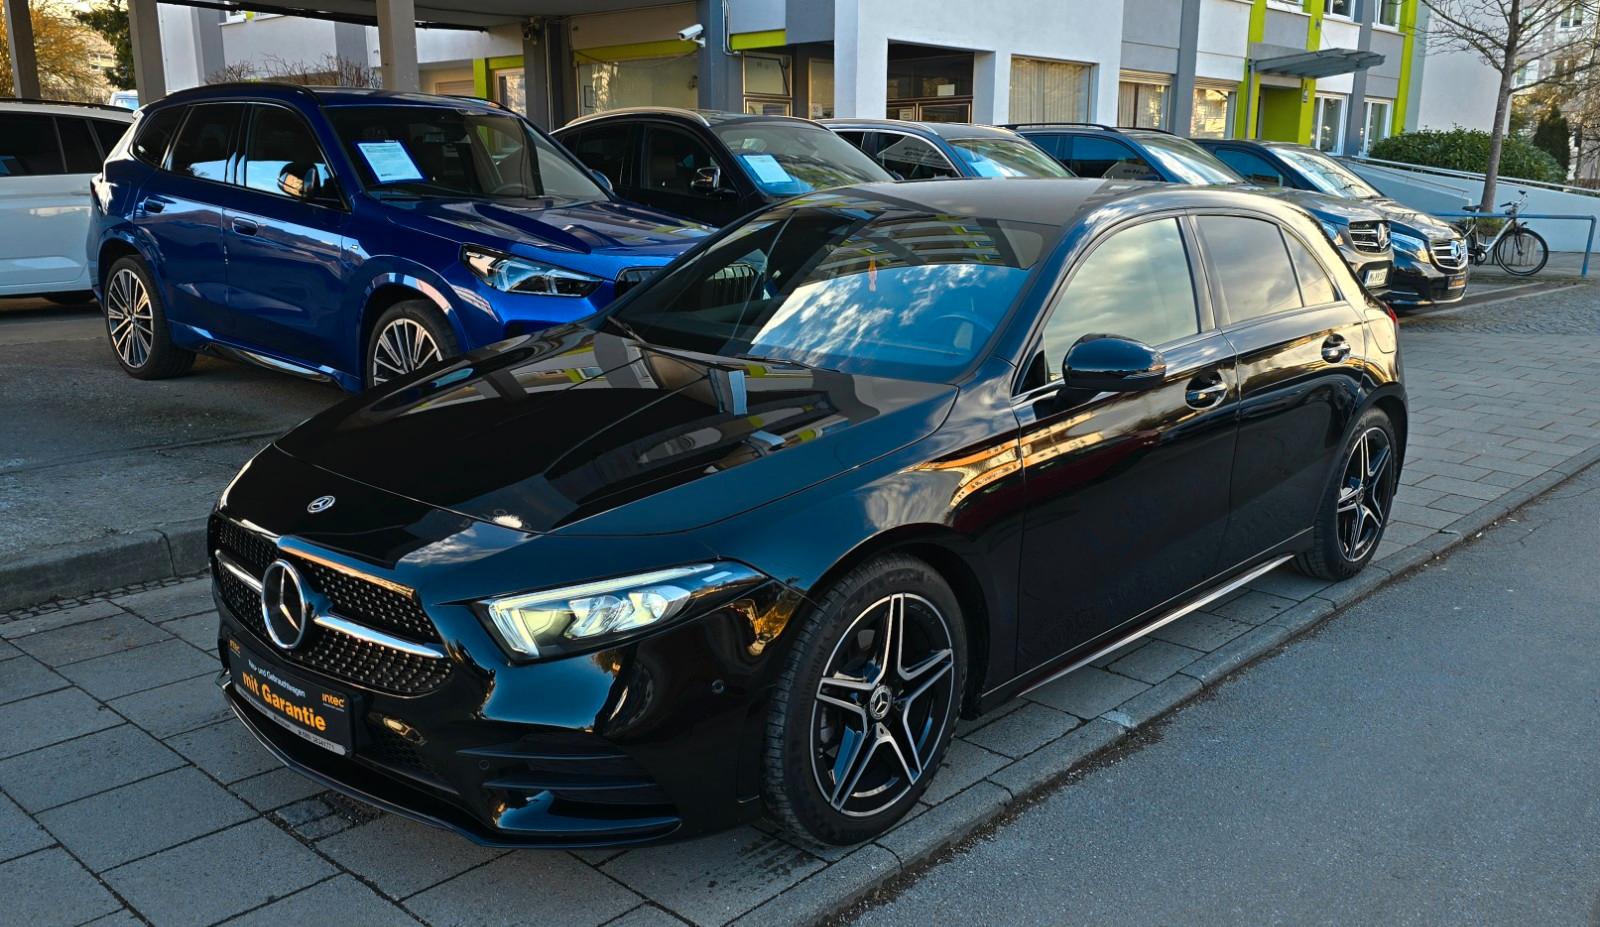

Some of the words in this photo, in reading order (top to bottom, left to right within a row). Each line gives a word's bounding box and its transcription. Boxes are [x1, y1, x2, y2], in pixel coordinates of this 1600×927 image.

[242, 672, 260, 696] mit
[261, 684, 327, 731] Garantie
[322, 693, 345, 708] intec
